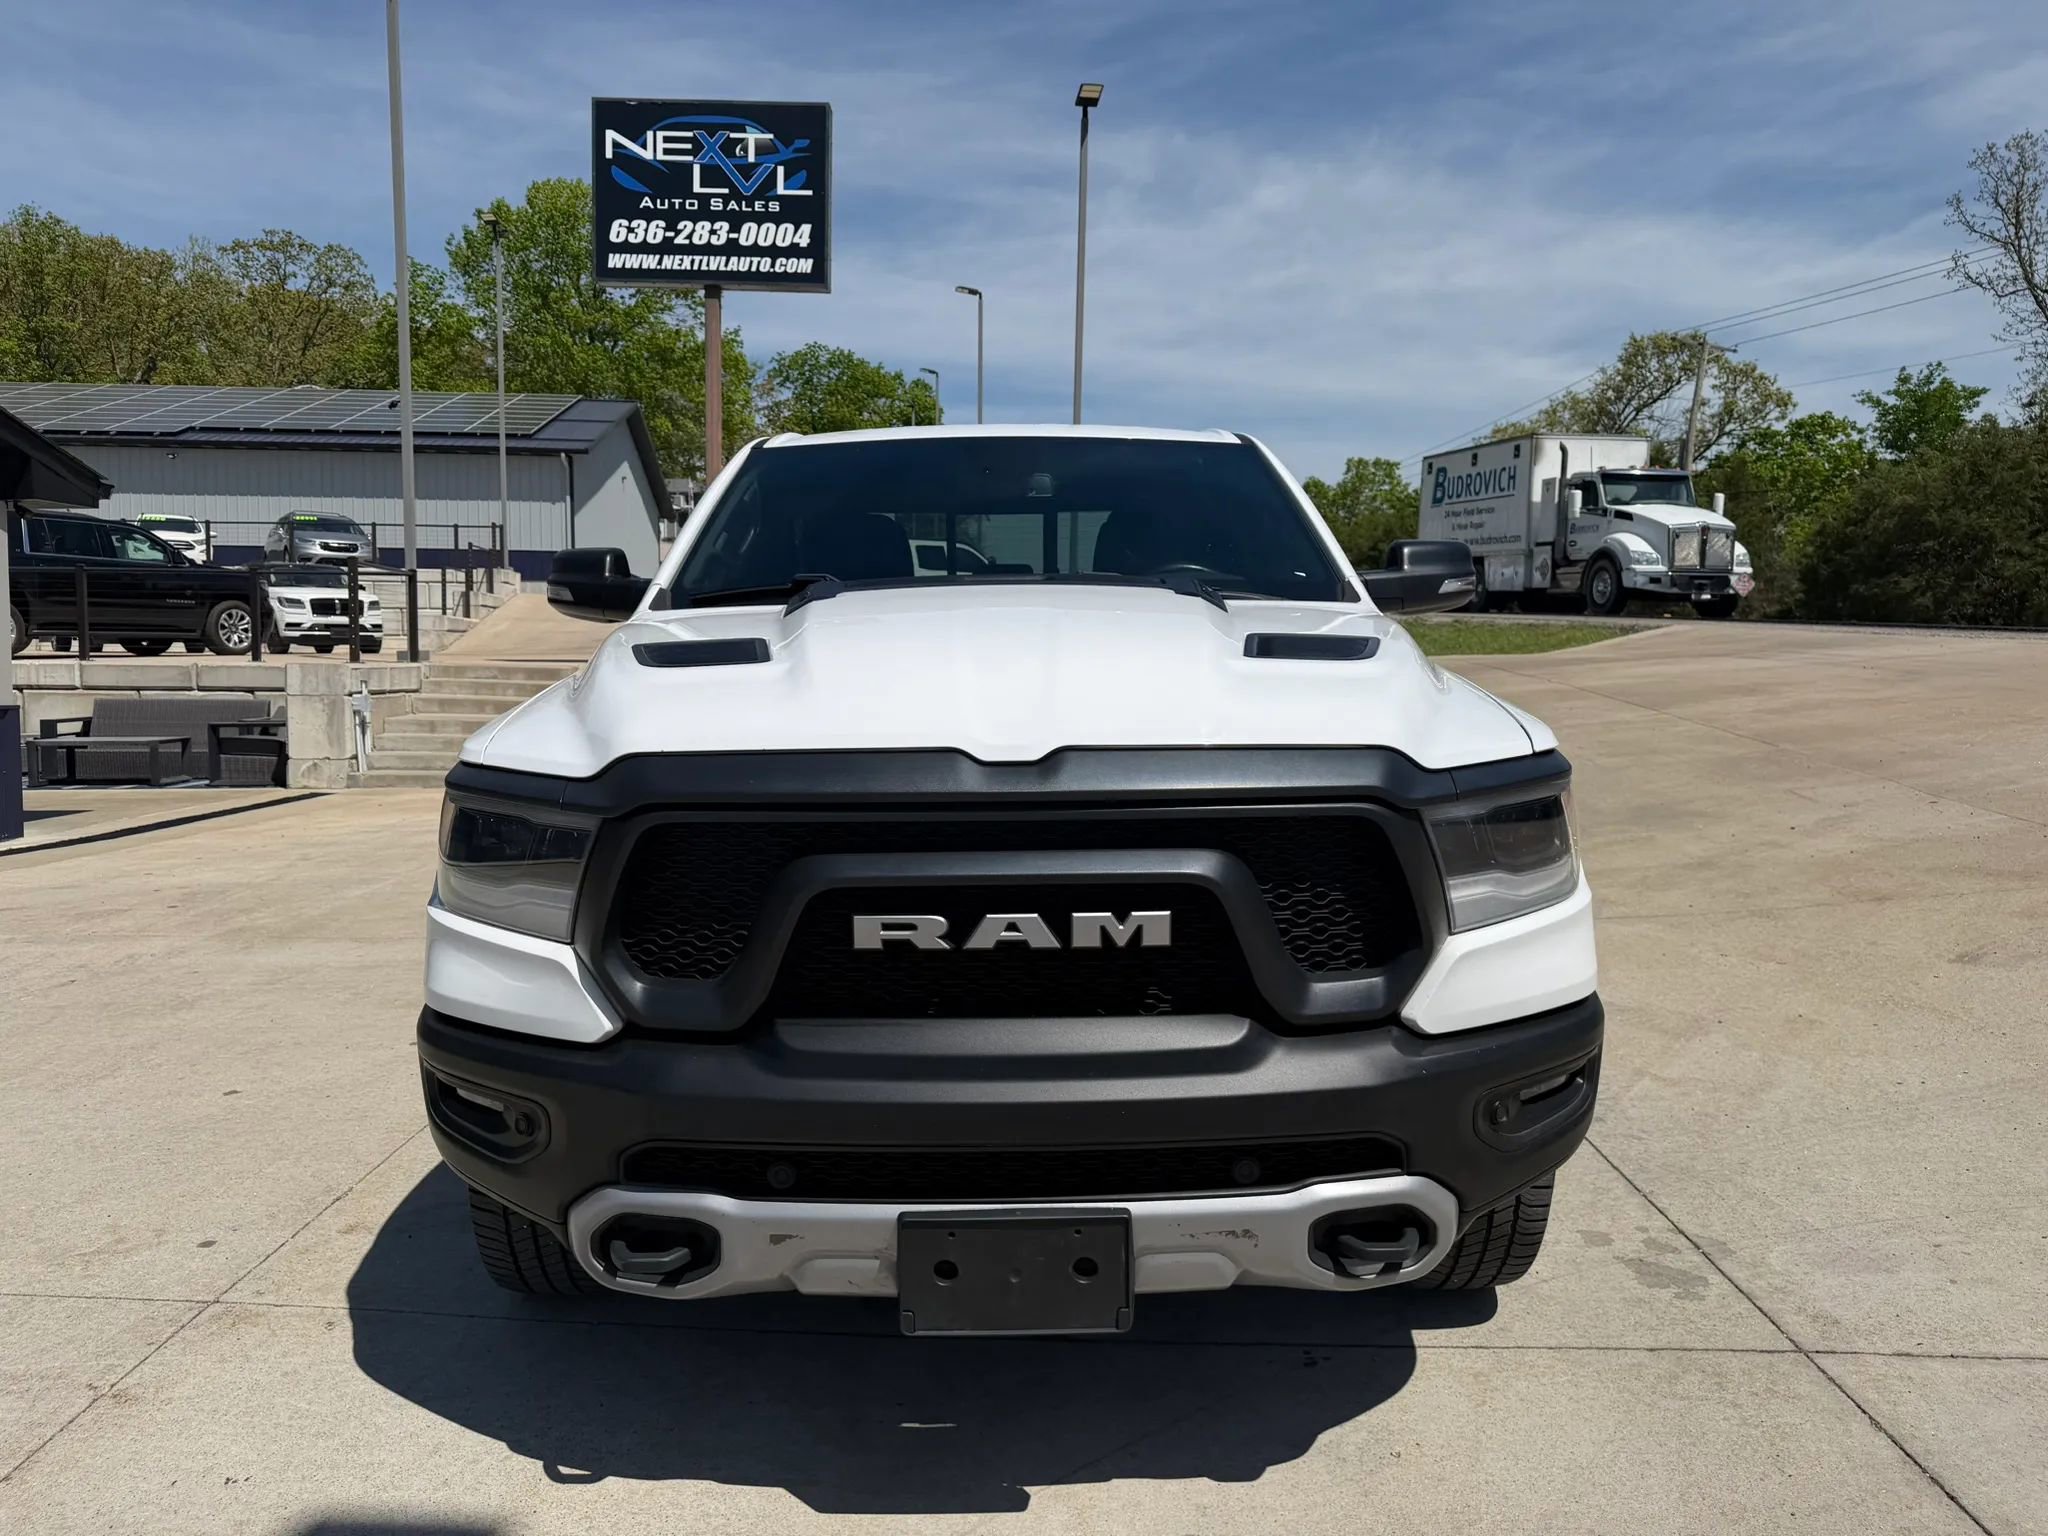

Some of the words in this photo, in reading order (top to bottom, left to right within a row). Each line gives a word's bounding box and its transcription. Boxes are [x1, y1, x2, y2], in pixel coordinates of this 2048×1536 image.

[604, 128, 774, 163] NEXT
[692, 162, 813, 196] LVL
[609, 218, 813, 248] 636-283-0004
[607, 252, 814, 274] WWW.NEXTLVLAUTO.COM
[1432, 465, 1517, 505] BUDROVICH
[853, 910, 1172, 949] RAM
